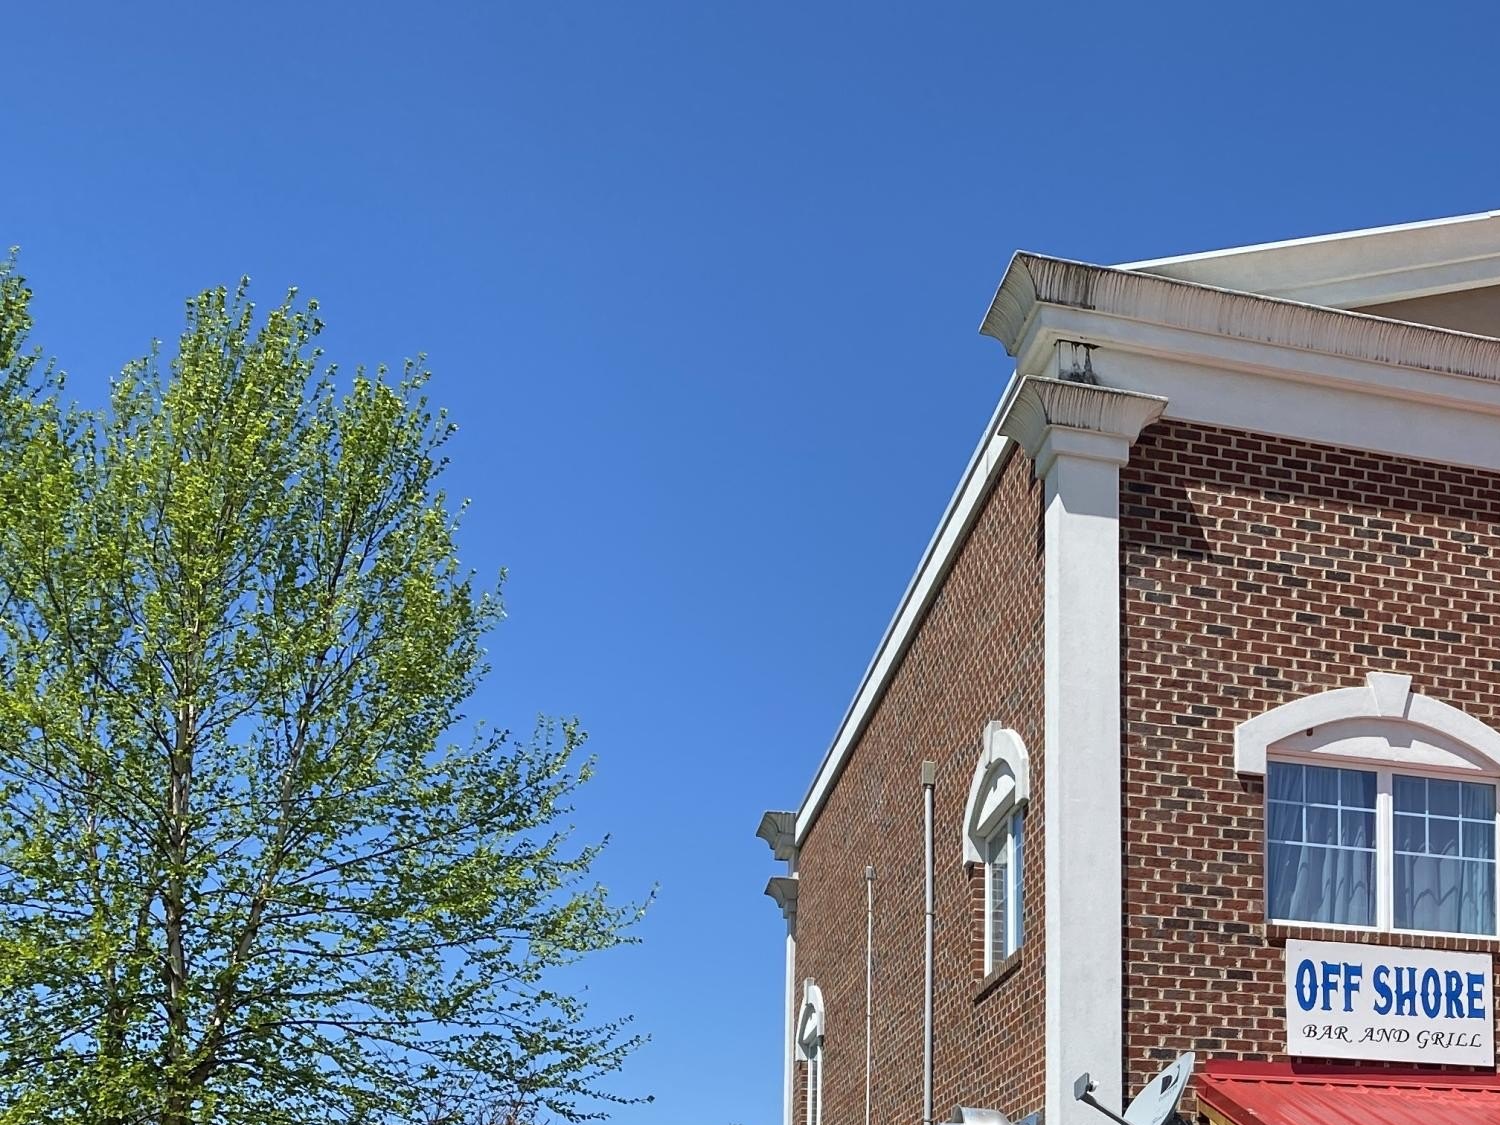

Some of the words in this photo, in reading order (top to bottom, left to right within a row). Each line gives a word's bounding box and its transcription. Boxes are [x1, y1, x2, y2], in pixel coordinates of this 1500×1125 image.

[1294, 958, 1363, 1012] OFF
[1373, 964, 1486, 1021] SHORE
[1302, 1024, 1353, 1043] BAR
[1358, 1027, 1410, 1043] AND
[1416, 1030, 1482, 1049] GRILL
